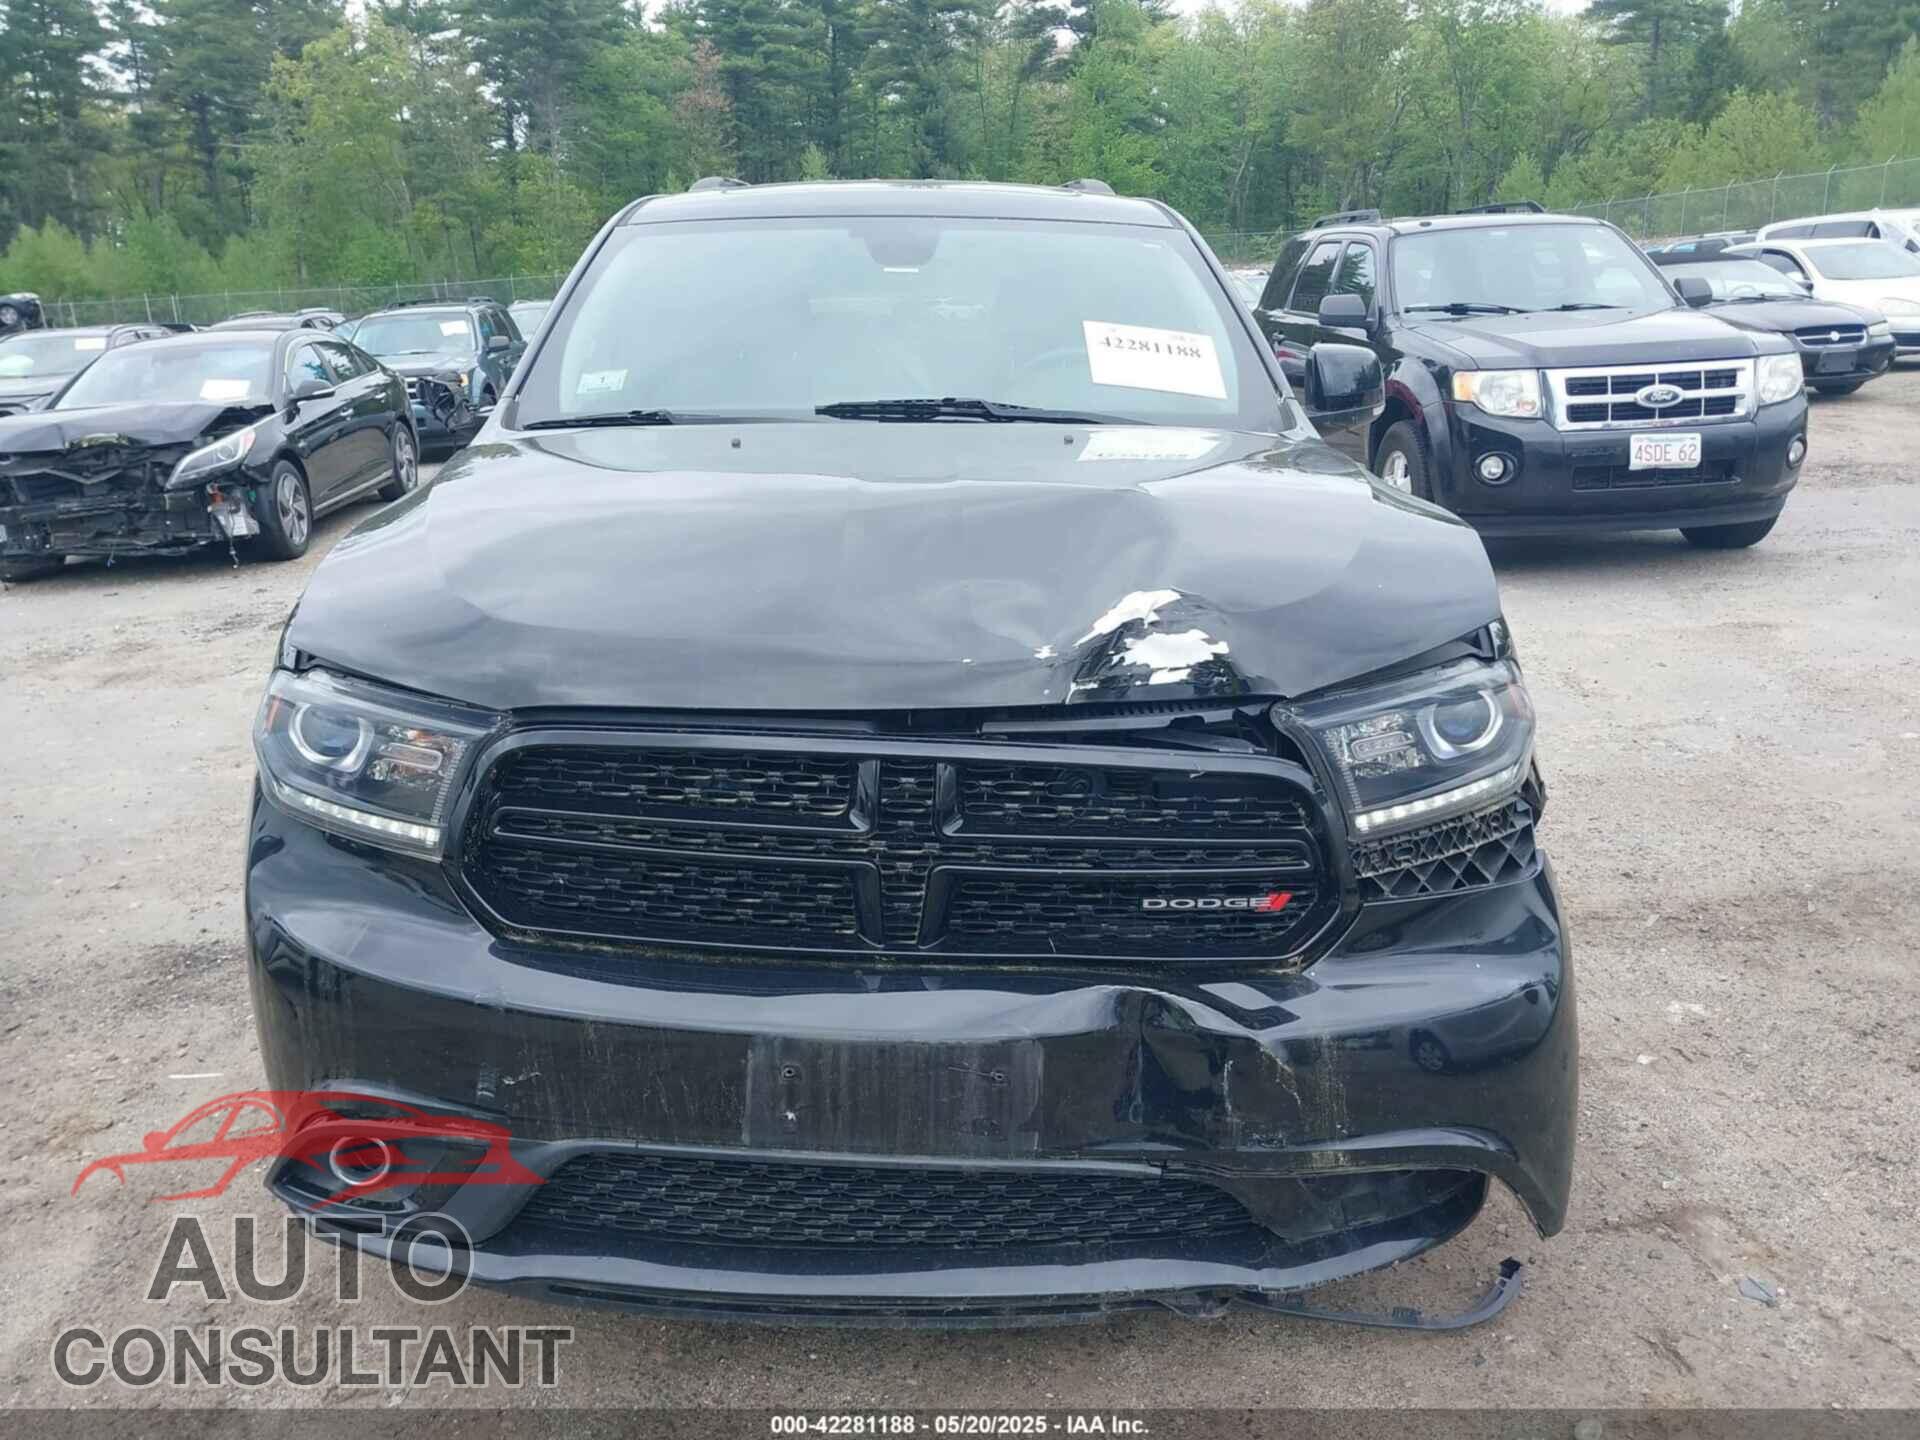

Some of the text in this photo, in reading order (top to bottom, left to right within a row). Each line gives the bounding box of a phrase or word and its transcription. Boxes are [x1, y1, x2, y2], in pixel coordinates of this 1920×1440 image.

[1100, 336, 1201, 358] 42281188
[1650, 389, 1674, 402] Ford
[1634, 443, 1697, 462] 4SDE 62
[1142, 898, 1272, 909] DODGE
